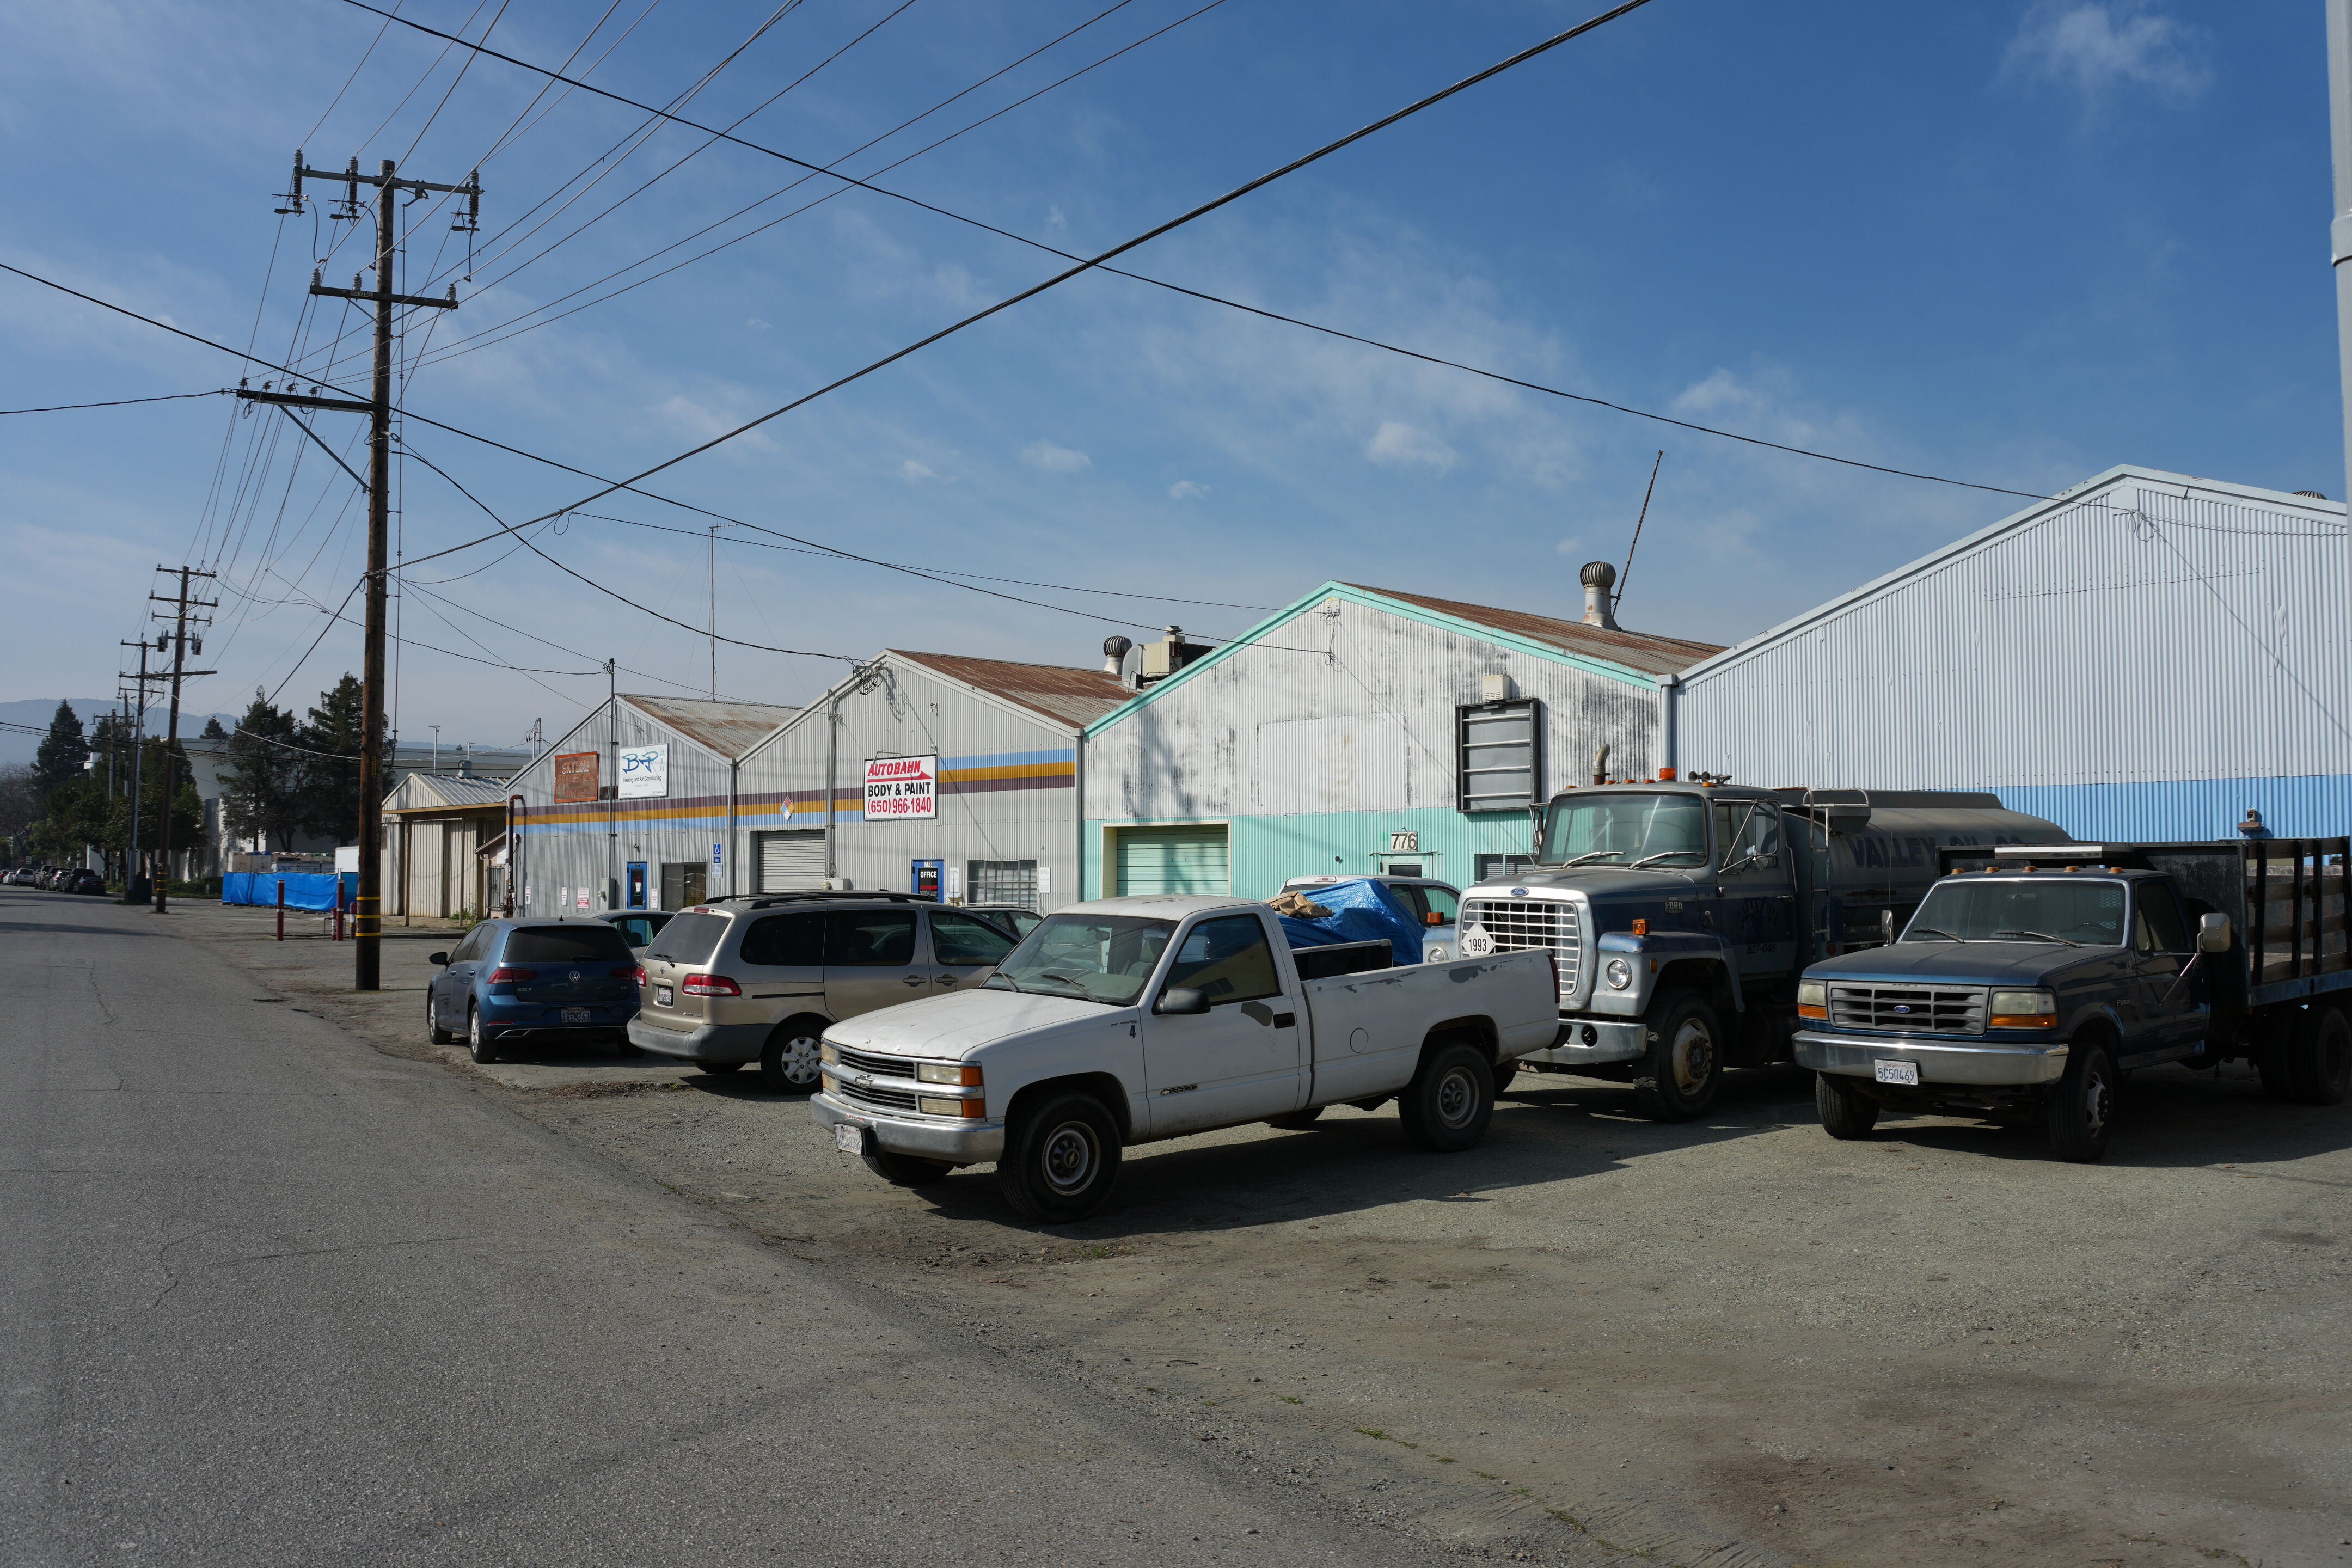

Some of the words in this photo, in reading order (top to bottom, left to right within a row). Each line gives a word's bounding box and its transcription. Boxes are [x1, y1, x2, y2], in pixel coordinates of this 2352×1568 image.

[622, 751, 659, 774] BP
[867, 759, 921, 776] AUTOBAHN
[868, 783, 892, 797] BODY
[895, 783, 902, 796] &
[904, 782, 931, 795] PAINT
[868, 798, 891, 814] (650)
[893, 797, 932, 814] 966-1840
[1391, 832, 1417, 849] 776
[1845, 836, 1936, 868] VALLEY
[1468, 938, 1487, 951] 1993
[1747, 943, 1775, 954] 827-046
[1129, 1025, 1136, 1038] 4
[1878, 1068, 1915, 1081] 5C50469
[1170, 1085, 1198, 1094] 3500
